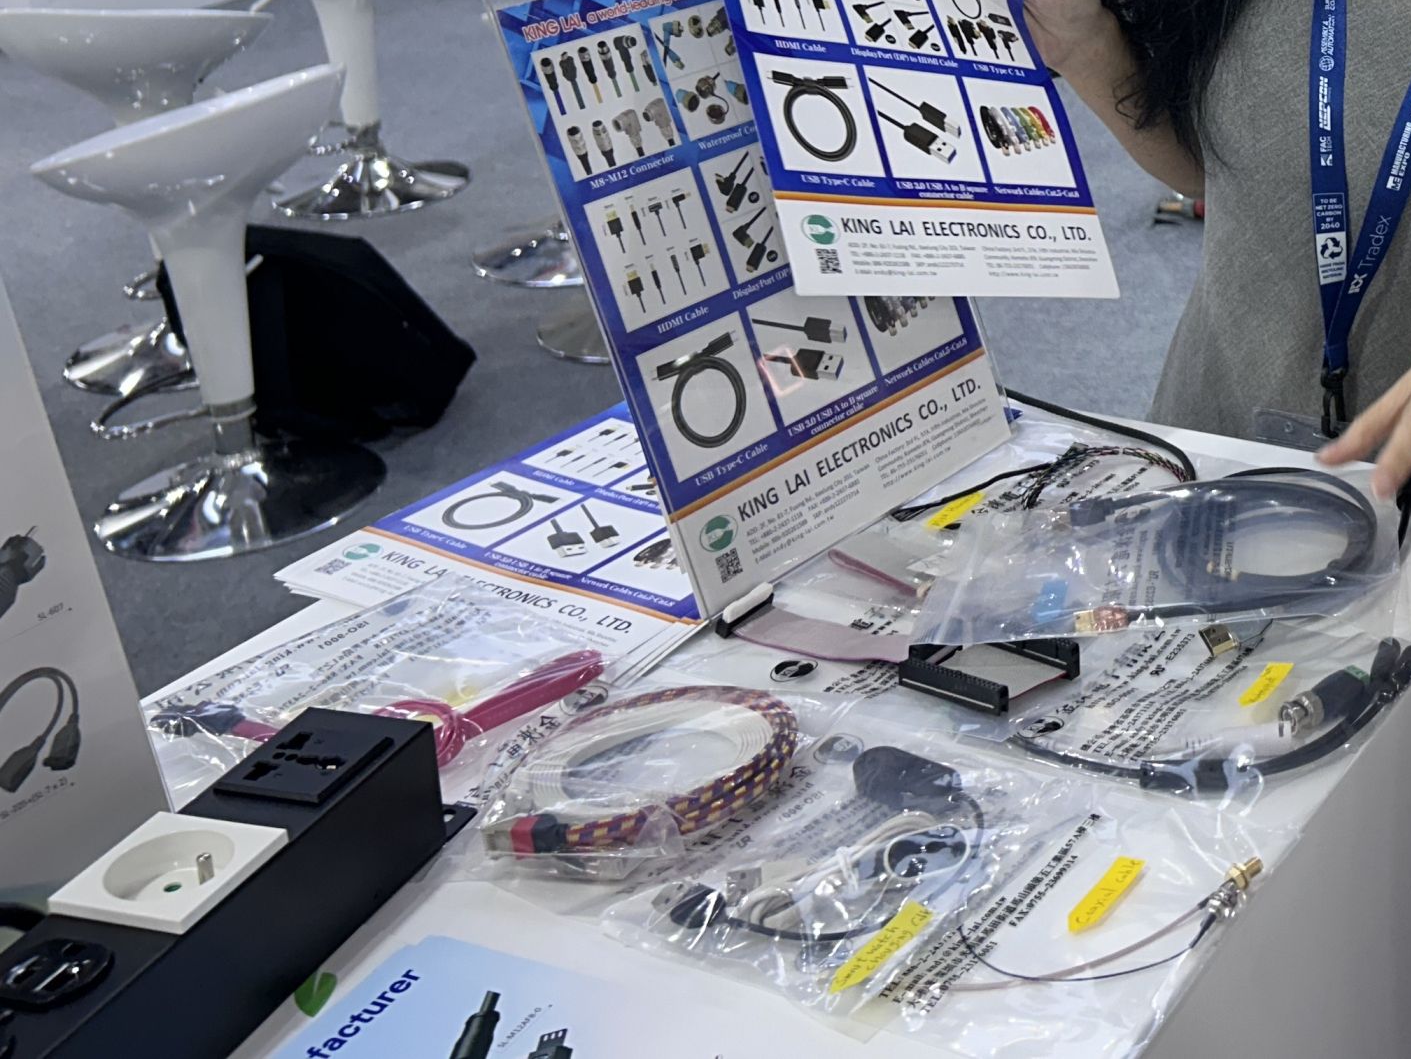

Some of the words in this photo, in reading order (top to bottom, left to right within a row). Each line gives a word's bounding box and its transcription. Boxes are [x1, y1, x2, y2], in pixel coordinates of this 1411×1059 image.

[521, 21, 561, 43] KING
[561, 13, 587, 33] LAI,
[586, 10, 597, 24] a
[775, 39, 800, 51] HDMI
[801, 43, 827, 53] Cable
[939, 59, 959, 69] Cable
[1319, 76, 1331, 131] NEPCON
[698, 128, 743, 151] Waterproof
[589, 169, 629, 190] M8-M12
[629, 153, 675, 176] Connector
[800, 173, 821, 184] USB
[849, 178, 876, 189] Cable
[1399, 152, 1411, 177] EXPO
[841, 217, 883, 235] KING
[889, 219, 916, 237] LAI
[924, 221, 1021, 240] ELECTRONICS
[1026, 224, 1057, 243] CO.,
[1061, 226, 1092, 242] LTD.
[1320, 222, 1340, 230] 2040
[1357, 213, 1393, 270] Tradex
[657, 317, 684, 334] HDMI
[684, 305, 709, 322] Cable
[884, 367, 914, 387] Network
[913, 354, 934, 373] Cables
[788, 422, 805, 438] USB
[817, 408, 833, 424] USB
[833, 404, 841, 417] A
[841, 400, 849, 412] to
[855, 384, 879, 405] square
[810, 414, 846, 436] connector
[845, 402, 864, 419] cable
[695, 470, 715, 487] USB
[715, 456, 746, 479] Type-C
[744, 443, 769, 460] Cable
[737, 486, 780, 522] KING
[785, 469, 811, 495] LAI
[815, 413, 913, 478] ELECTRONICS
[918, 399, 948, 421] CO.,
[951, 377, 981, 402] LTD.
[852, 462, 870, 475] Taiwan
[382, 551, 425, 570] KING
[424, 564, 450, 579] LA
[558, 604, 588, 622] CO.,
[597, 615, 632, 635] LTD.
